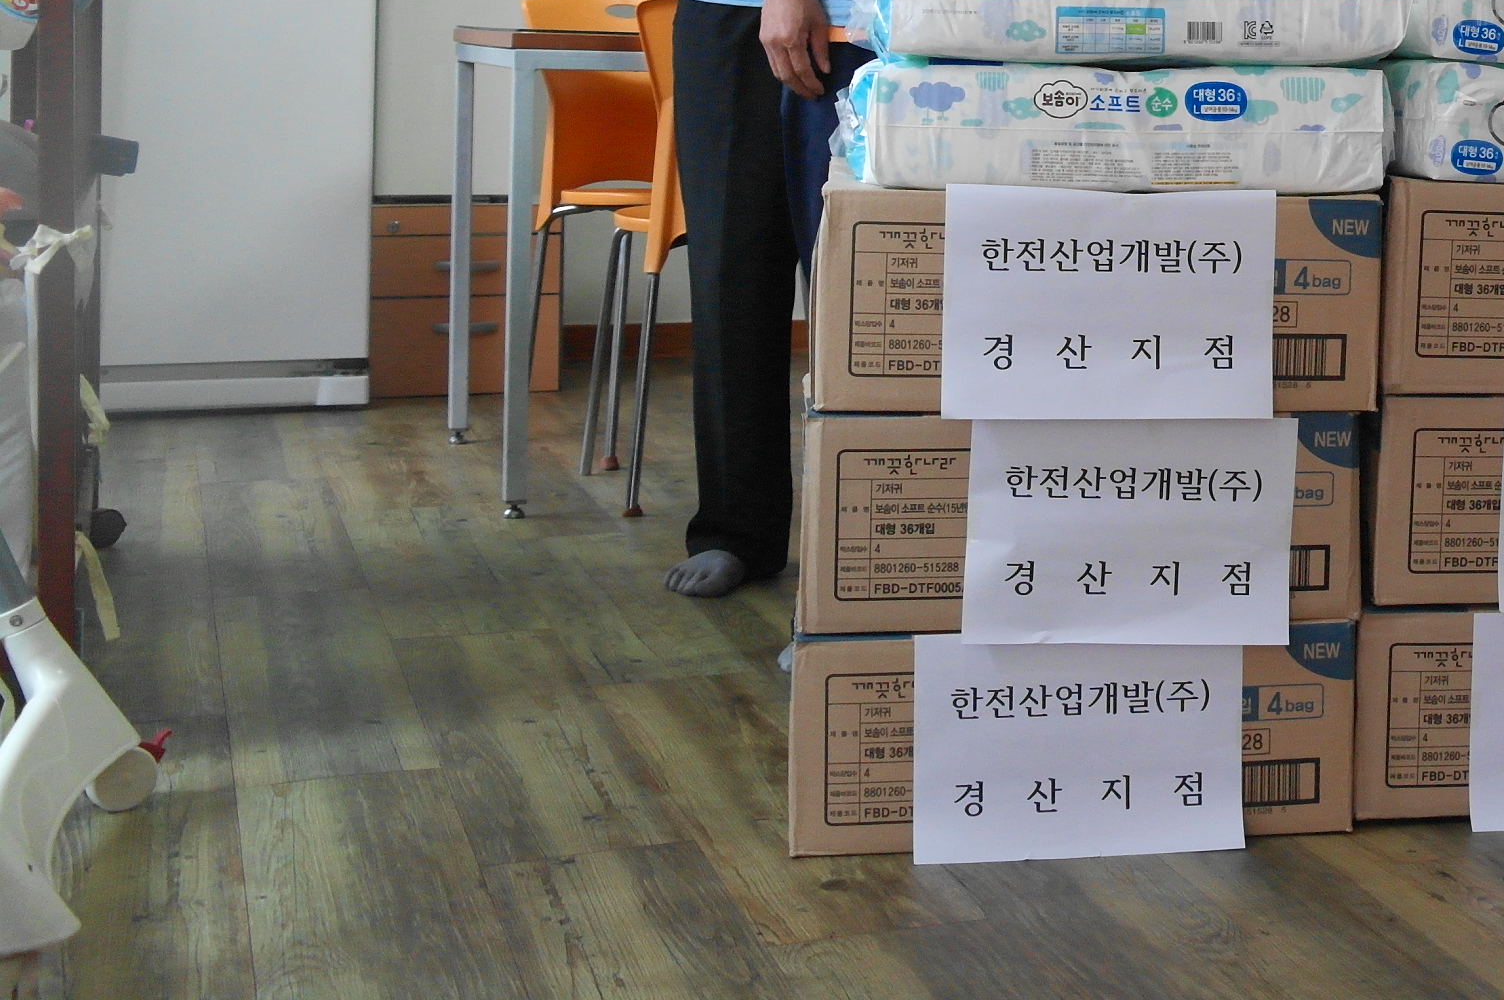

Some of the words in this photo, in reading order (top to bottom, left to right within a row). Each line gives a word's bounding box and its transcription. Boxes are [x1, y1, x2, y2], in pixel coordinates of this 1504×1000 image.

[1461, 25, 1480, 38] 대형
[1481, 27, 1496, 40] 36
[1042, 90, 1078, 106] 보솜이
[1090, 95, 1140, 112] 소프트
[1151, 96, 1173, 111] 순수
[1193, 89, 1215, 102] 대형
[1218, 89, 1235, 101] 36
[1459, 145, 1478, 158] 대형
[1479, 147, 1494, 159] 36
[1332, 219, 1369, 236] NEW
[982, 238, 1241, 273] 한전산업개발(주)
[1456, 245, 1480, 256] 기저귀
[891, 257, 918, 269] 기저귀
[1454, 285, 1473, 295] 대형
[890, 299, 911, 310] 대형
[1453, 303, 1458, 312] 4
[889, 319, 895, 328] 4
[984, 334, 1013, 370] 경
[1057, 335, 1092, 369] 산
[1132, 335, 1160, 369] 지
[1204, 335, 1233, 369] 점
[1314, 430, 1352, 448] NEW
[864, 454, 956, 475] 깨끗한나라
[1449, 461, 1472, 471] 기저귀
[875, 484, 903, 495] 기저귀
[1006, 465, 1263, 502] 한전산업개발(주)
[901, 503, 925, 513] 소프트
[1446, 500, 1465, 510] 대형
[875, 524, 896, 535] 대형
[900, 523, 935, 535] 36개입
[1446, 519, 1451, 528] 4
[874, 544, 880, 553] 4
[874, 562, 959, 574] 8801260-515288
[1005, 561, 1034, 595] 경
[1077, 561, 1112, 594] 산
[1150, 561, 1179, 595] 지
[1222, 562, 1250, 595] 점
[874, 583, 964, 595] FBD-DTF0005
[1303, 642, 1340, 660] NEW
[1425, 675, 1449, 685] 기저귀
[852, 678, 914, 698] 깨끗한
[951, 679, 1209, 719] 한전산업개발(주)
[864, 707, 891, 718] 기저귀
[1423, 714, 1442, 725] 대형
[1446, 713, 1470, 724] 36개
[1242, 733, 1263, 750] 28
[1423, 733, 1428, 742] 4
[865, 747, 885, 759] 대형
[1422, 752, 1470, 761] 8801260-
[864, 768, 870, 777] 4
[954, 781, 983, 816] 경
[1027, 778, 1062, 813] 산
[1102, 775, 1131, 809] 지
[1174, 772, 1202, 806] 점
